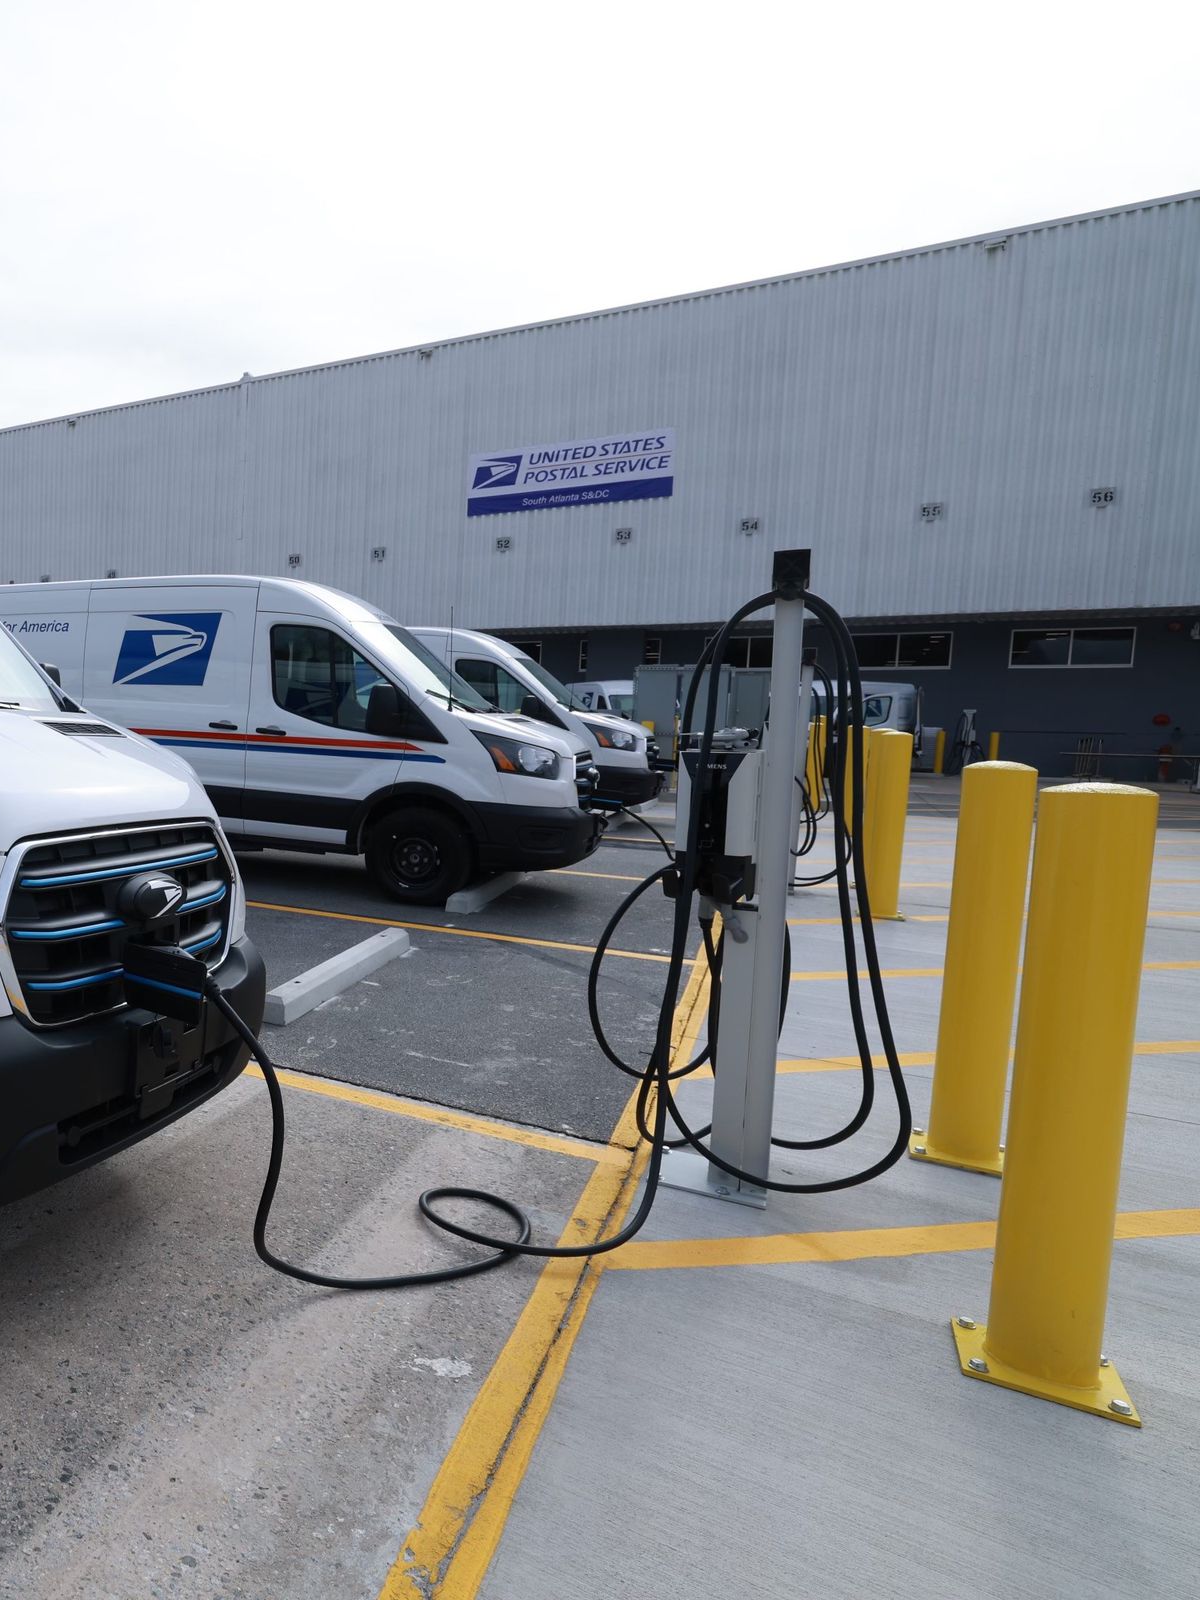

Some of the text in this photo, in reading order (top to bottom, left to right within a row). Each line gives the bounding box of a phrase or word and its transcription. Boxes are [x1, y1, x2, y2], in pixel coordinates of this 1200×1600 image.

[529, 436, 666, 465] UNITED STATES
[523, 455, 671, 484] POSTAL SERVICE
[522, 489, 610, 507] South Atlanta S&DC
[1092, 491, 1114, 503] 56
[921, 506, 941, 517] 55
[741, 521, 759, 531] 54
[616, 531, 631, 541] 53
[497, 540, 510, 549] 52
[374, 550, 385, 558] 51
[289, 556, 300, 565] 50
[19, 620, 70, 632] America
